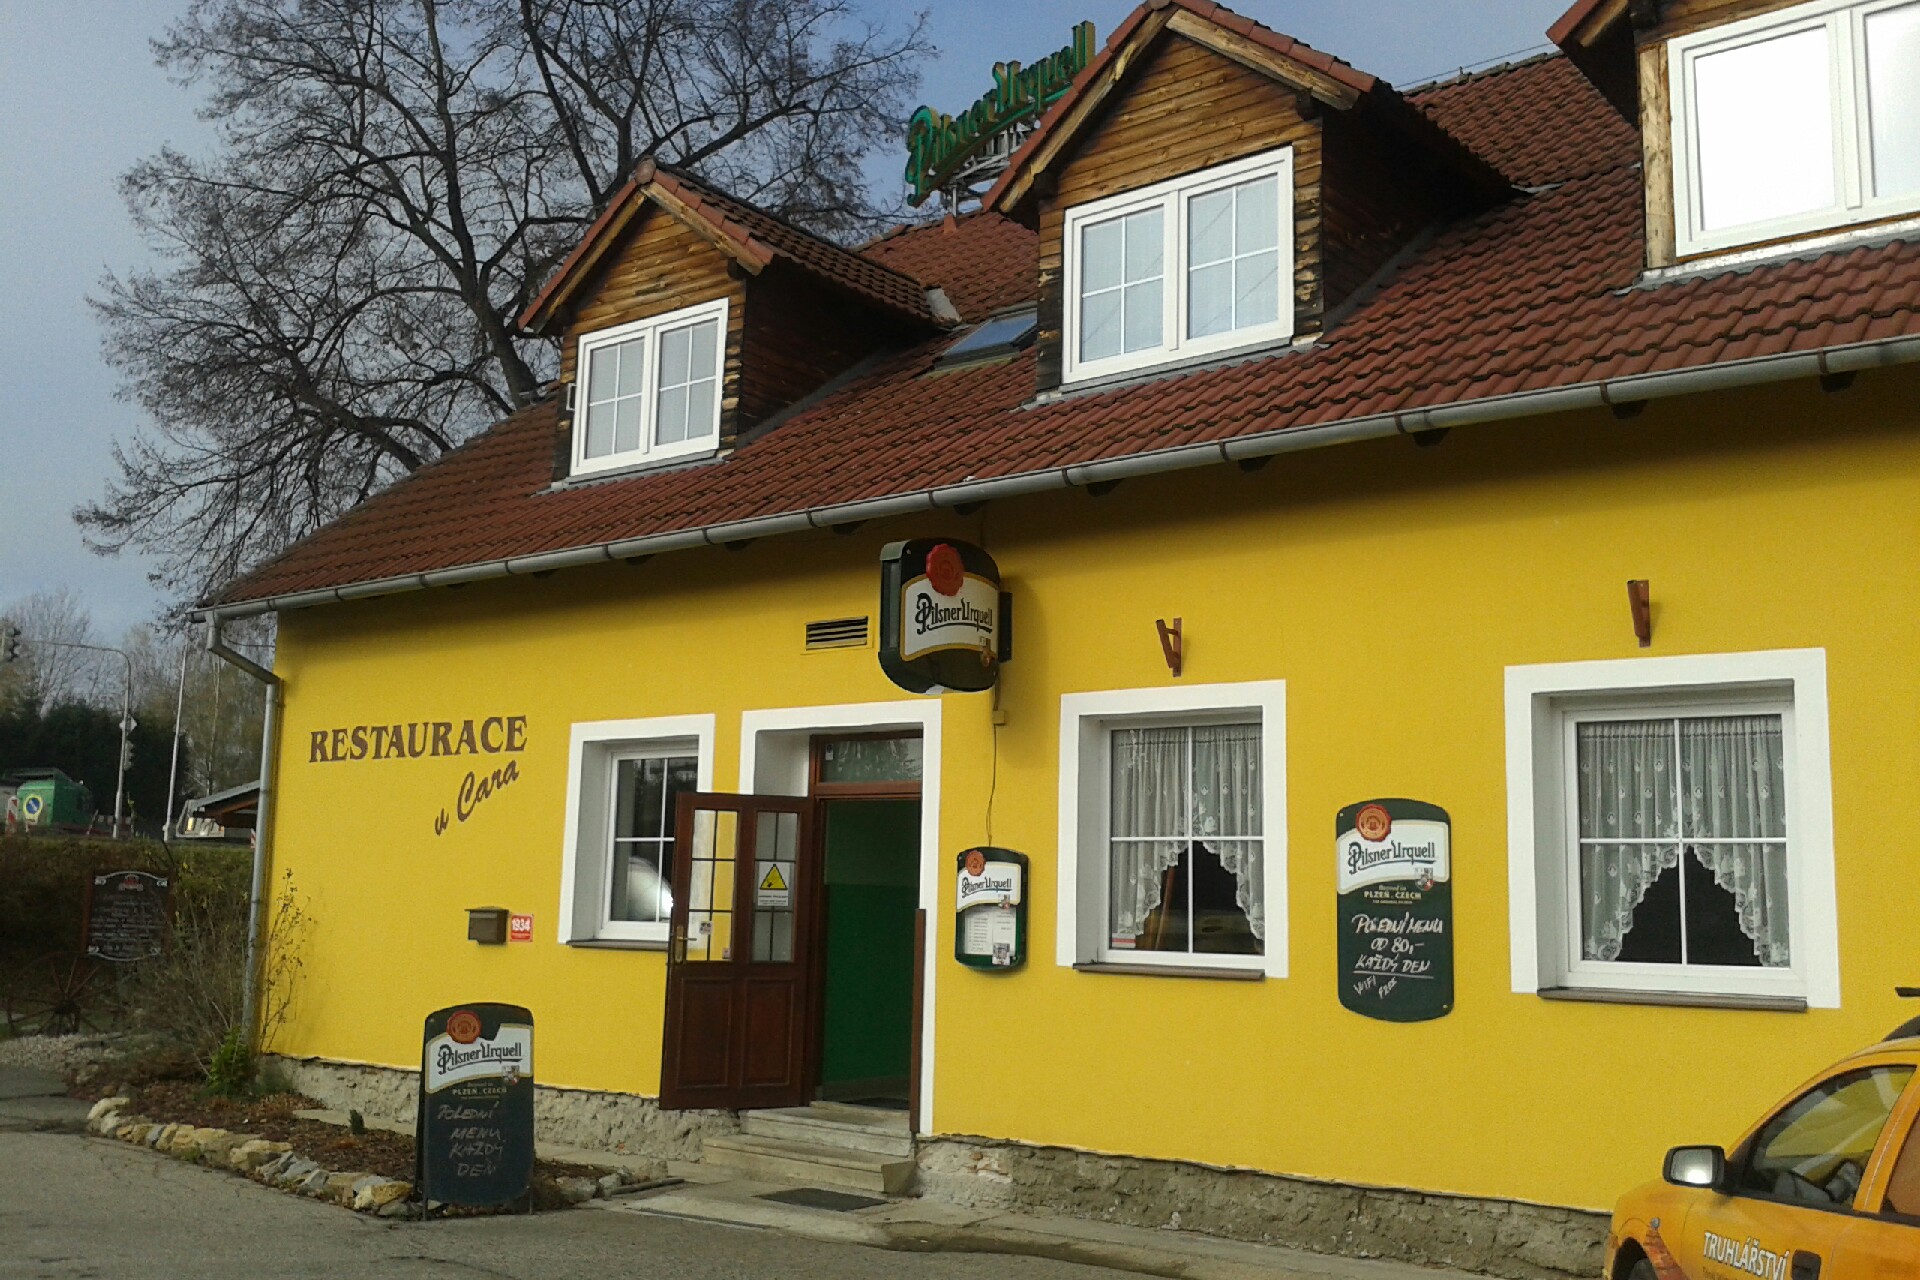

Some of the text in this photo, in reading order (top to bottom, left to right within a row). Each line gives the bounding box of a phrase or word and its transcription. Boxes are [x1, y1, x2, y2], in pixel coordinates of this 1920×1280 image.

[915, 592, 993, 636] Pilsner Urquell
[308, 714, 528, 764] RESTAURACE
[434, 759, 520, 836] u Cara
[1347, 840, 1436, 875] Pilsner Urquell
[984, 876, 1012, 892] Urquell
[1395, 891, 1422, 900] CZECH
[436, 1042, 523, 1076] Pilsner Urquell
[1703, 1231, 1790, 1280] TRUHLÁŘSTVÍ
